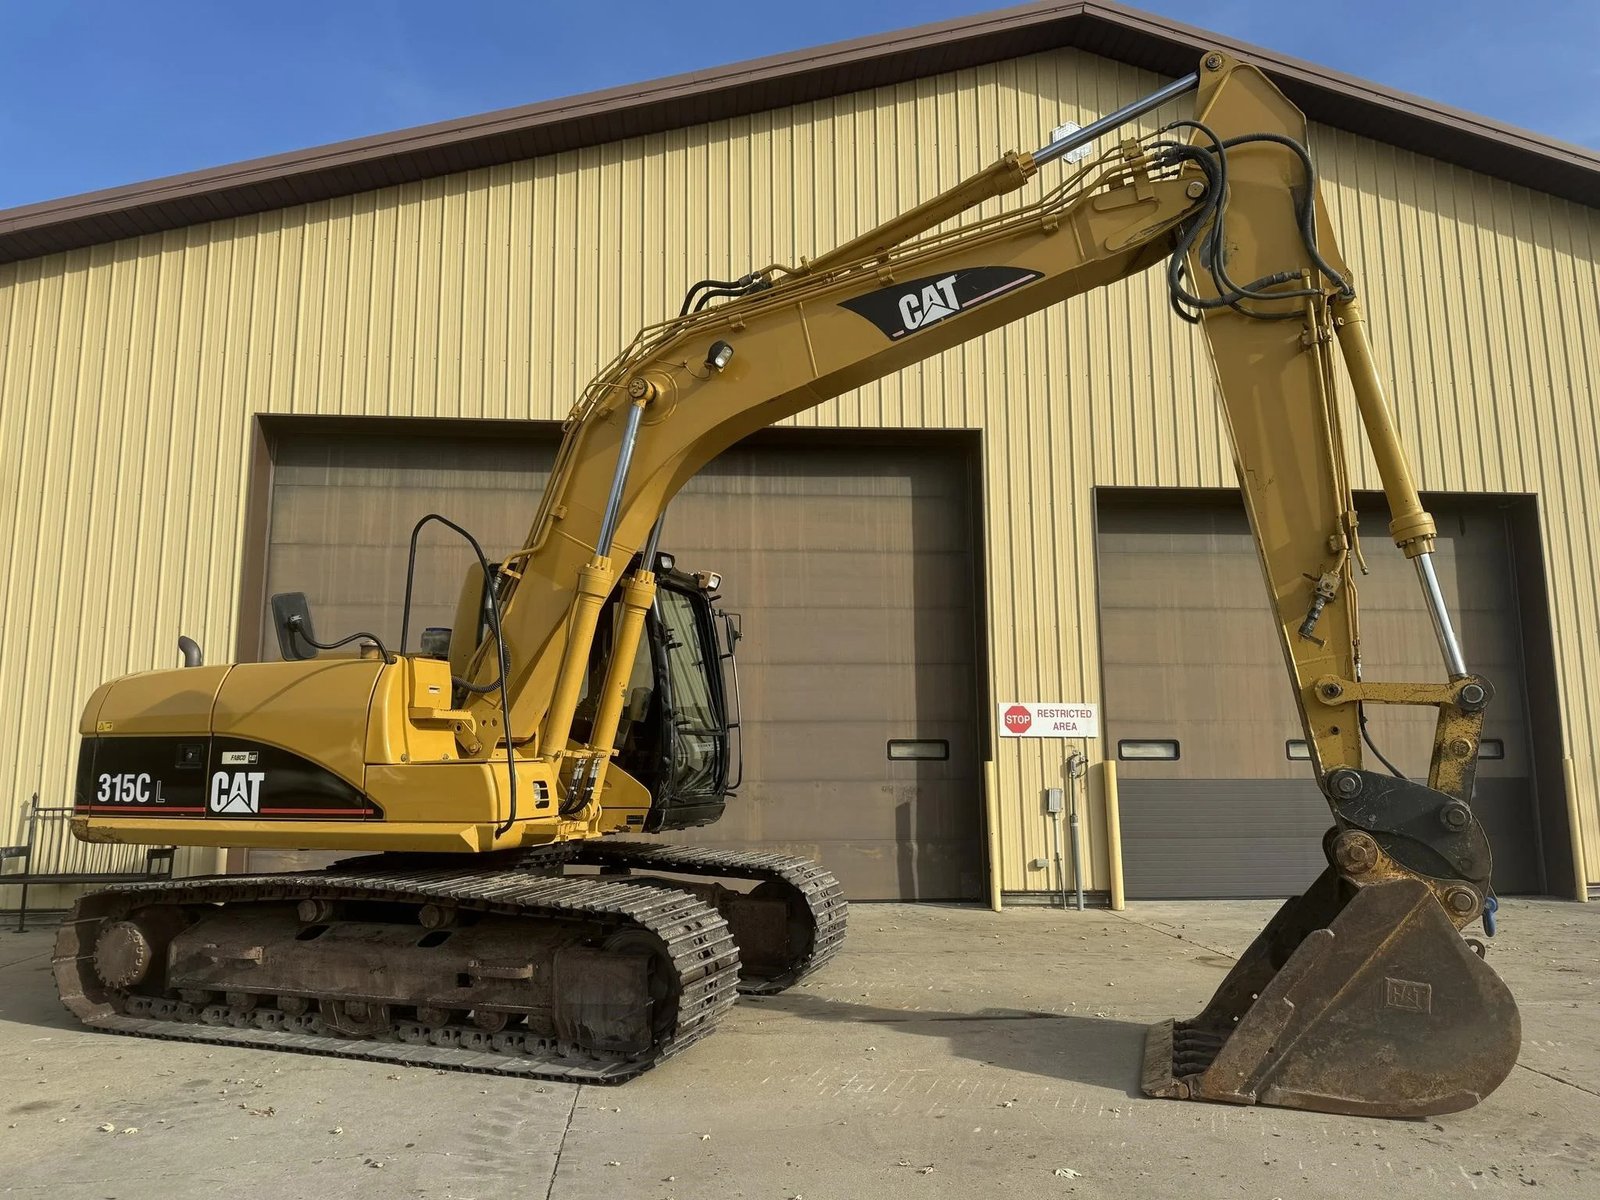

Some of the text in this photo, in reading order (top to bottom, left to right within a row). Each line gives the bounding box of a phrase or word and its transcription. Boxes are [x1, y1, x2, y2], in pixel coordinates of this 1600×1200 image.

[898, 275, 960, 330] CAT
[1006, 715, 1031, 724] STOP
[1037, 709, 1092, 719] RESTRICTED
[1053, 722, 1078, 731] AREA
[97, 773, 166, 803] 315C L
[210, 771, 265, 813] CAT
